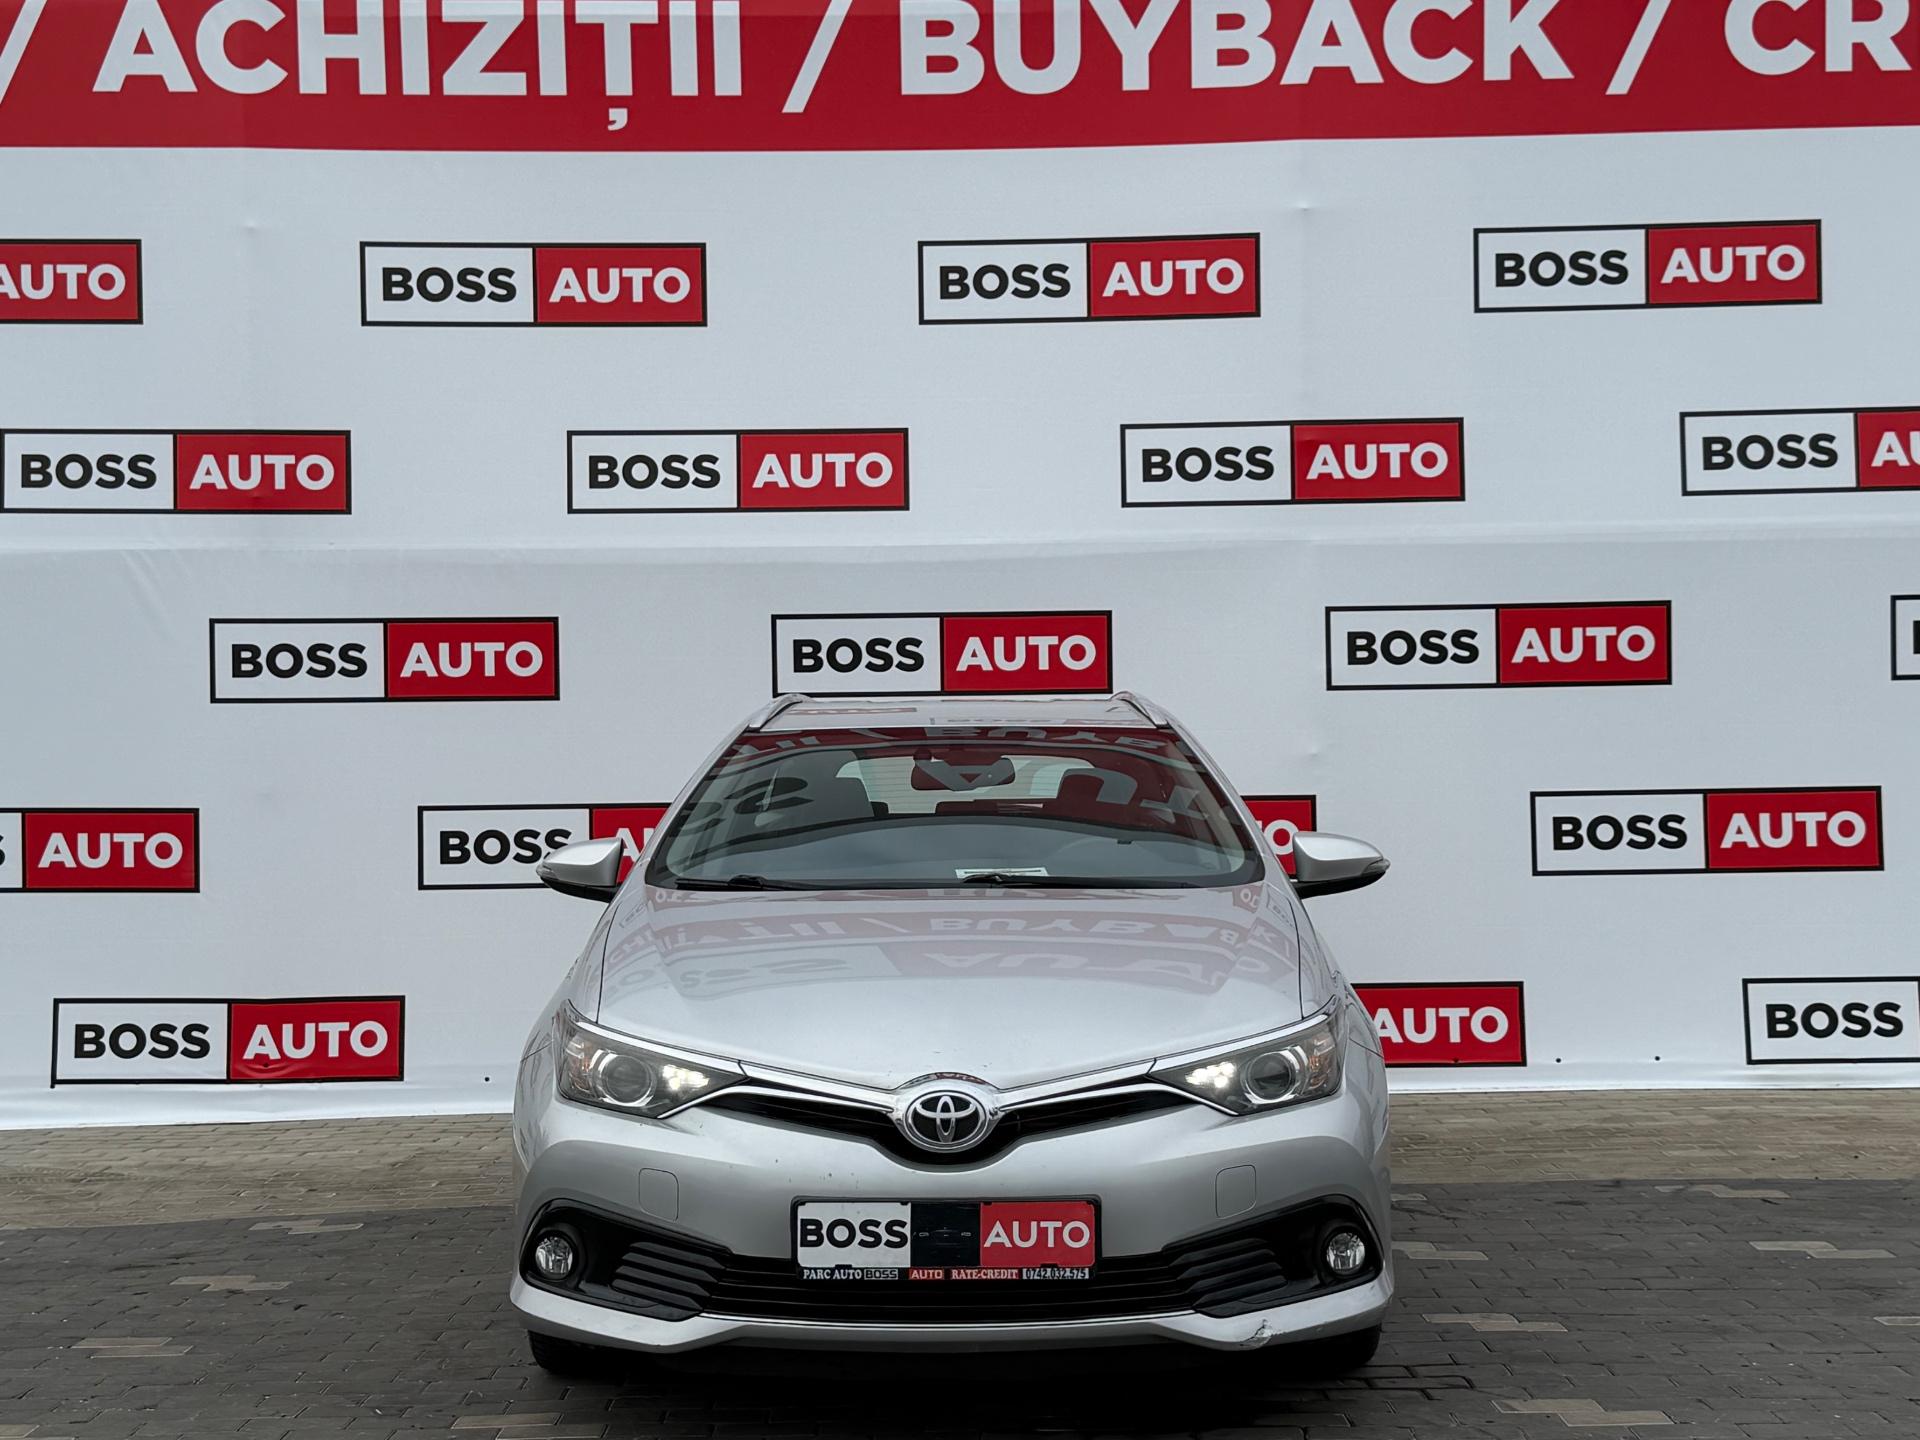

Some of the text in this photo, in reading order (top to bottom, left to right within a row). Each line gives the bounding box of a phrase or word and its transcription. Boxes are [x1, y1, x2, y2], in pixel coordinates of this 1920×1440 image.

[900, 0, 1574, 95] BUYBACK
[940, 258, 1244, 299] BOSS AUTO
[1496, 245, 1805, 287] BOSS AUTO
[383, 267, 690, 303] BOSS AUTO
[589, 452, 892, 489] BOSS AUTO
[1142, 443, 1448, 482] BOSS AUTO
[1703, 434, 1838, 470] BOSS
[21, 454, 334, 490] BOSS AUTO
[232, 642, 542, 678] BOSS AUTO
[793, 635, 1096, 673] BOSS AUTO
[1347, 626, 1655, 665] BOSS AUTO
[1553, 811, 1866, 850] BOSS AUTO
[38, 833, 182, 868] AUTO
[1373, 1006, 1509, 1043] AUTO
[1766, 1002, 1903, 1038] BOSS
[74, 1021, 387, 1059] BOSS AUTO
[800, 1219, 1090, 1248] BOSS AUTO
[803, 1269, 831, 1279] PARC
[833, 1269, 861, 1279] AUTO
[864, 1269, 898, 1279] BOSS
[911, 1269, 943, 1279] AUTO
[952, 1269, 1018, 1279] RATE-CREDIT
